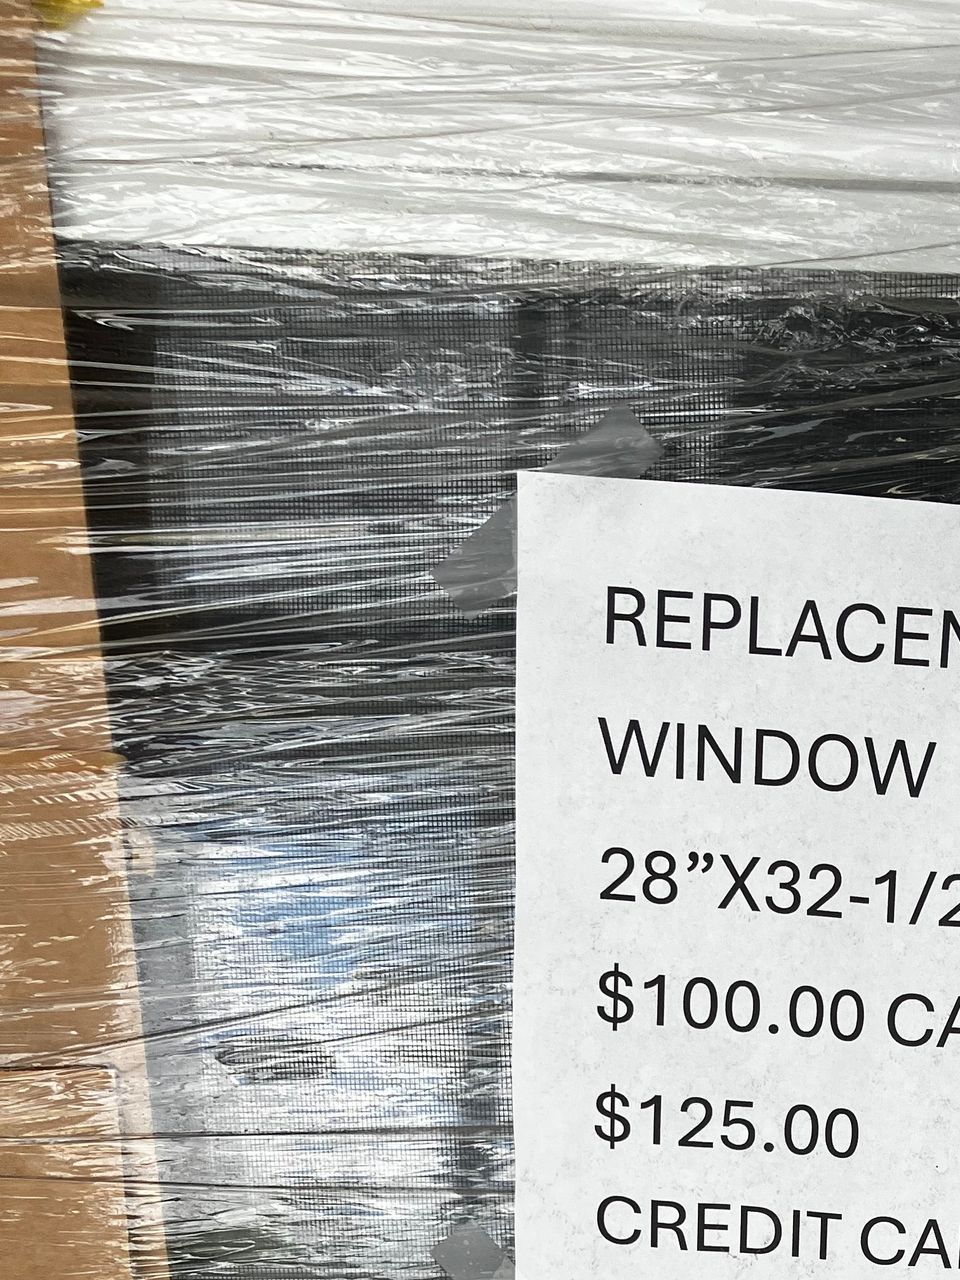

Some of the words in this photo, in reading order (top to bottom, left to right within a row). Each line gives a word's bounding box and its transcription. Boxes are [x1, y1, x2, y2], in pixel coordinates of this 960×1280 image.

[598, 717, 937, 798] WINDOW
[597, 962, 865, 1042] $100.00
[594, 1083, 859, 1159] $125.00
[596, 1195, 843, 1260] CREDIT
